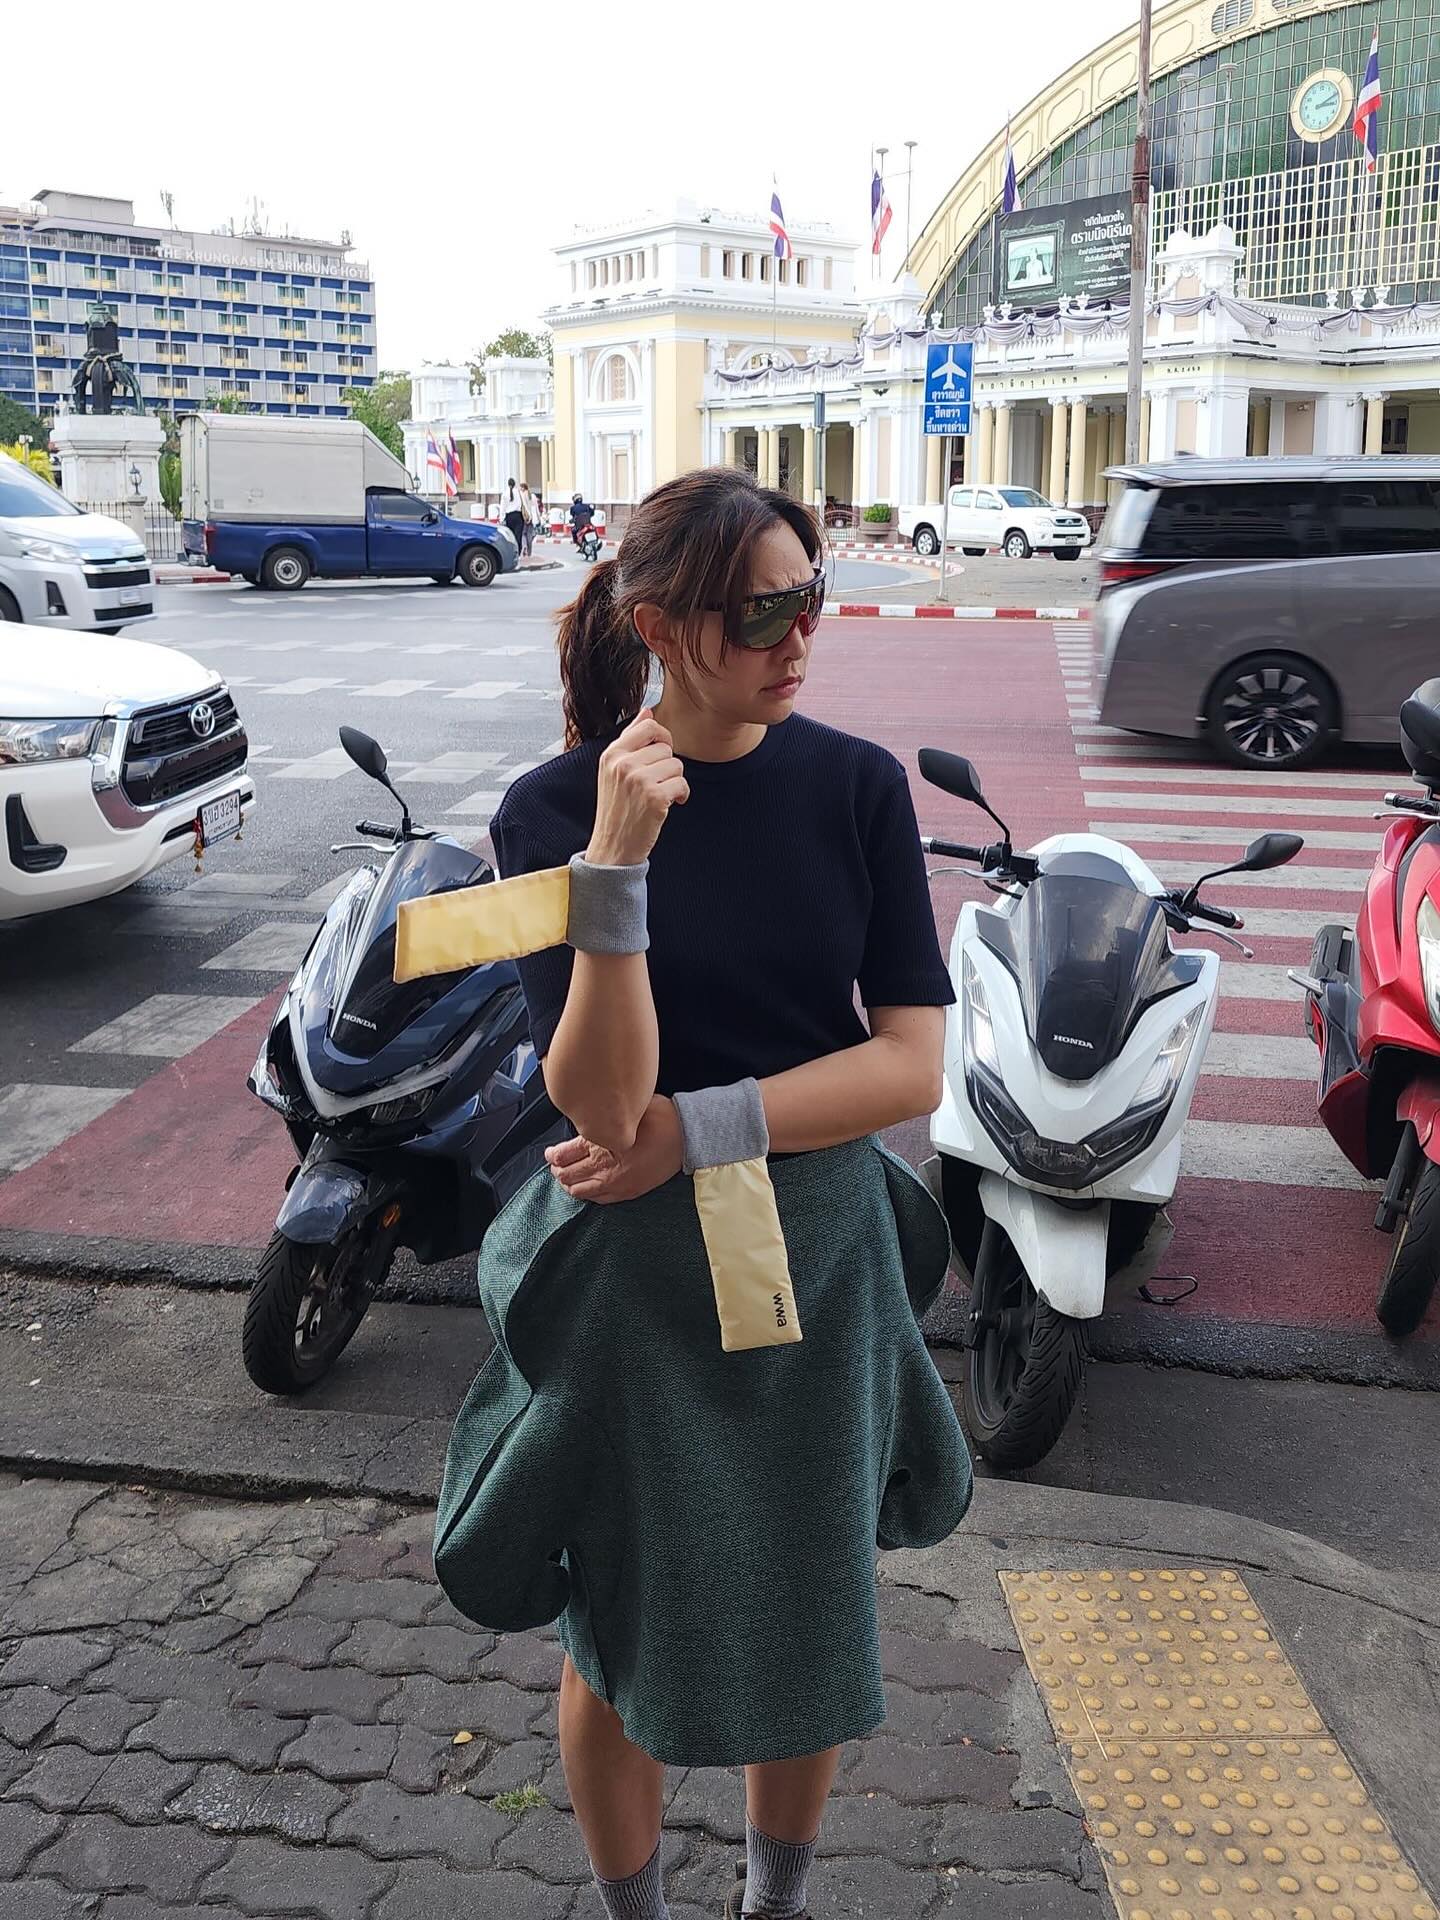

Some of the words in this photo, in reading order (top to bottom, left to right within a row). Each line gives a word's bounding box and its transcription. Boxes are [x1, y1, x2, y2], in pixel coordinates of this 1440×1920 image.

[155, 245, 180, 259] THE
[220, 795, 239, 817] 3294
[342, 1012, 377, 1031] HONDA
[1053, 1034, 1094, 1049] HONDA
